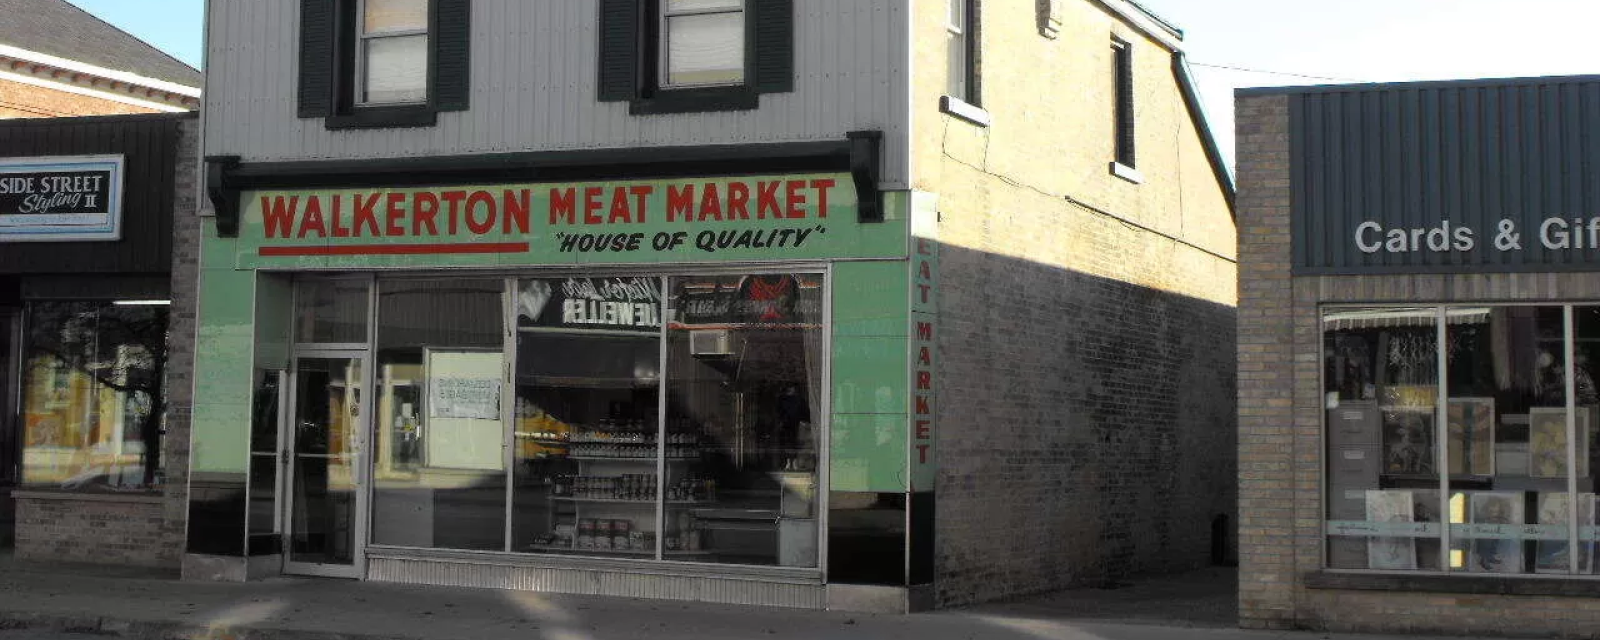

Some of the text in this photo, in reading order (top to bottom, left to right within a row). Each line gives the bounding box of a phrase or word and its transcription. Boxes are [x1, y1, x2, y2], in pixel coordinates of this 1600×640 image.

[0, 175, 103, 194] SIDE STREET
[18, 192, 82, 213] Styling
[260, 179, 836, 239] WALKERTON MEAT MARKET
[556, 224, 826, 253] "HOUSE OF QUALITY"
[1354, 220, 1475, 253] Cards
[1493, 218, 1522, 252] &
[916, 321, 932, 464] MARKET
